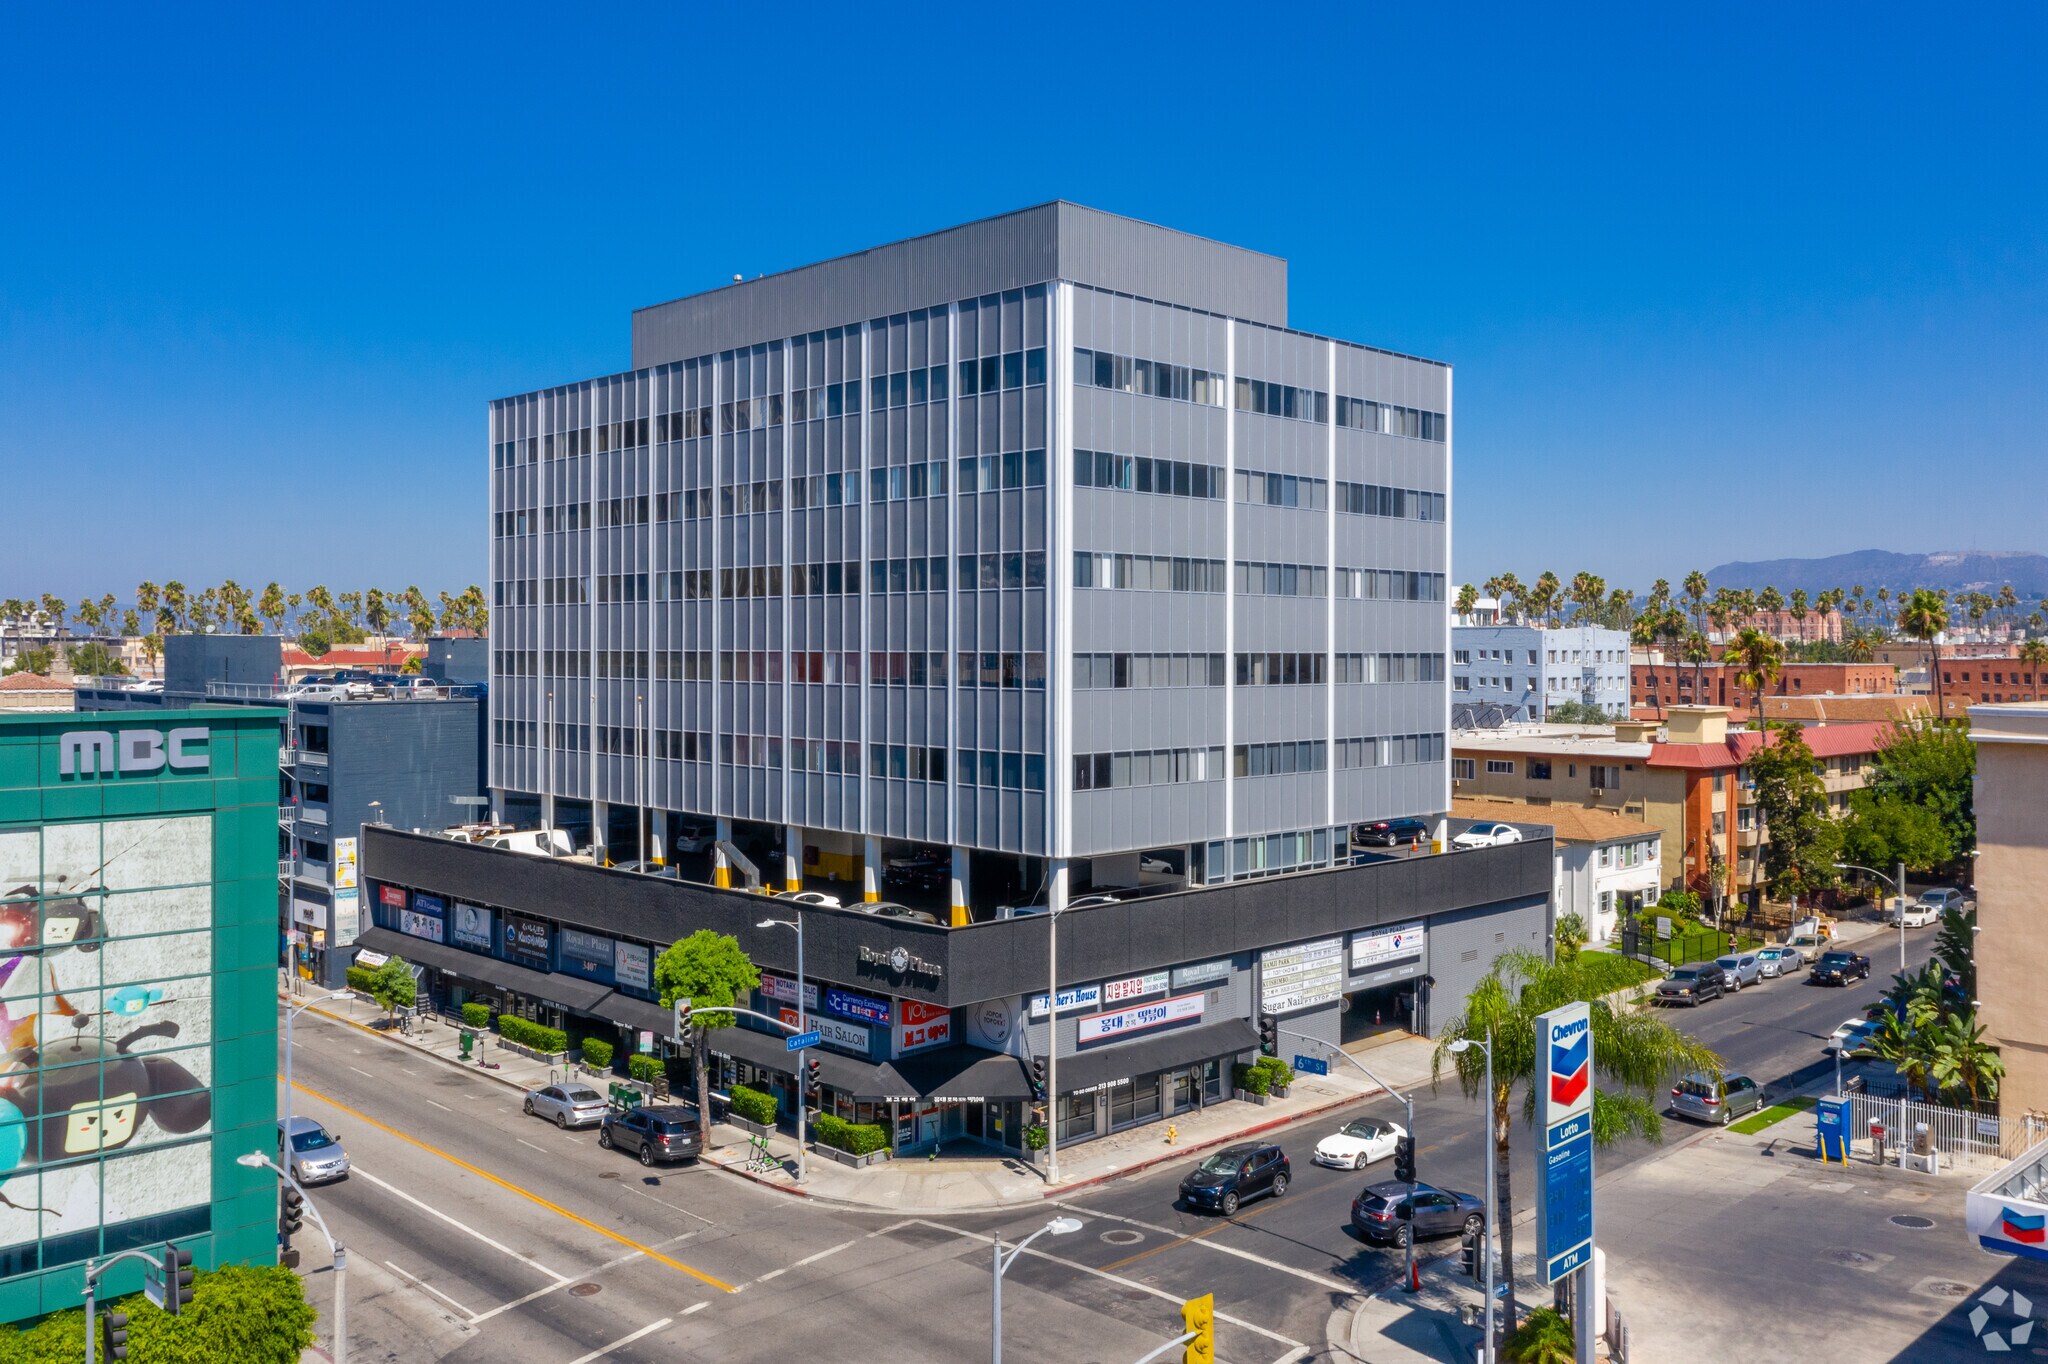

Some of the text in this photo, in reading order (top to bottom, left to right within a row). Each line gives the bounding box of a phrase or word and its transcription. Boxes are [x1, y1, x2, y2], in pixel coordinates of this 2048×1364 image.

[60, 727, 209, 775] MBC
[416, 898, 442, 912] ATI College
[1372, 926, 1406, 937] ROYAL PLAZA
[566, 931, 610, 952] Royal Plaza
[860, 946, 942, 976] Royal Plaza
[1153, 973, 1168, 982] MASSAGE
[1182, 964, 1223, 978] Royal Plaza
[776, 979, 796, 990] NOTARY
[556, 1003, 568, 1011] PLAZA
[842, 994, 886, 1012] Currency Exchange
[1044, 993, 1073, 1009] Fher's
[1076, 990, 1096, 1002] House
[1263, 996, 1303, 1013] Sugar Nail
[908, 1004, 926, 1021] VOG
[1101, 1015, 1123, 1032] 홍대
[1552, 1017, 1588, 1042] Chevron
[789, 1036, 818, 1048] Catalina
[810, 1020, 865, 1047] HAIR SALON
[904, 1023, 948, 1047] 보그 헤어
[1298, 1058, 1323, 1072] 6th St
[1117, 1077, 1129, 1086] 5500
[1560, 1122, 1578, 1139] Lotto
[1549, 1150, 1570, 1165] Gasoline
[1564, 1252, 1578, 1270] ATM
